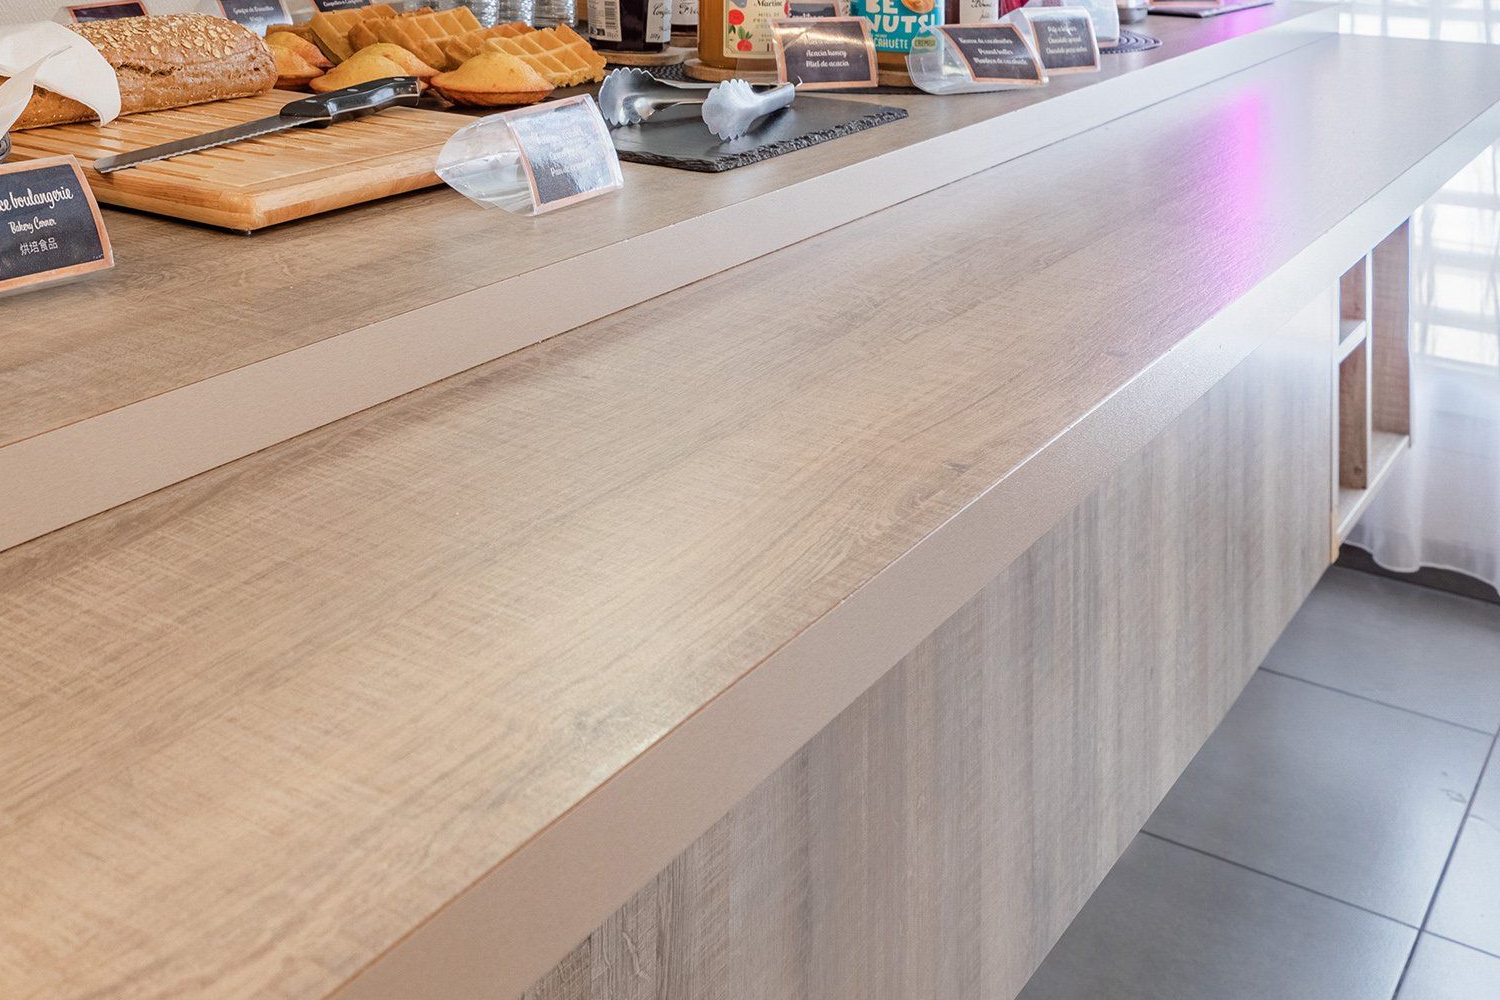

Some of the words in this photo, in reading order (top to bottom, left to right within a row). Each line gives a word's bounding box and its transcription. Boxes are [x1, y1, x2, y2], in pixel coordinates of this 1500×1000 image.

[9, 186, 73, 213] boulangerie
[8, 219, 34, 235] Bakery
[33, 217, 57, 230] Corner
